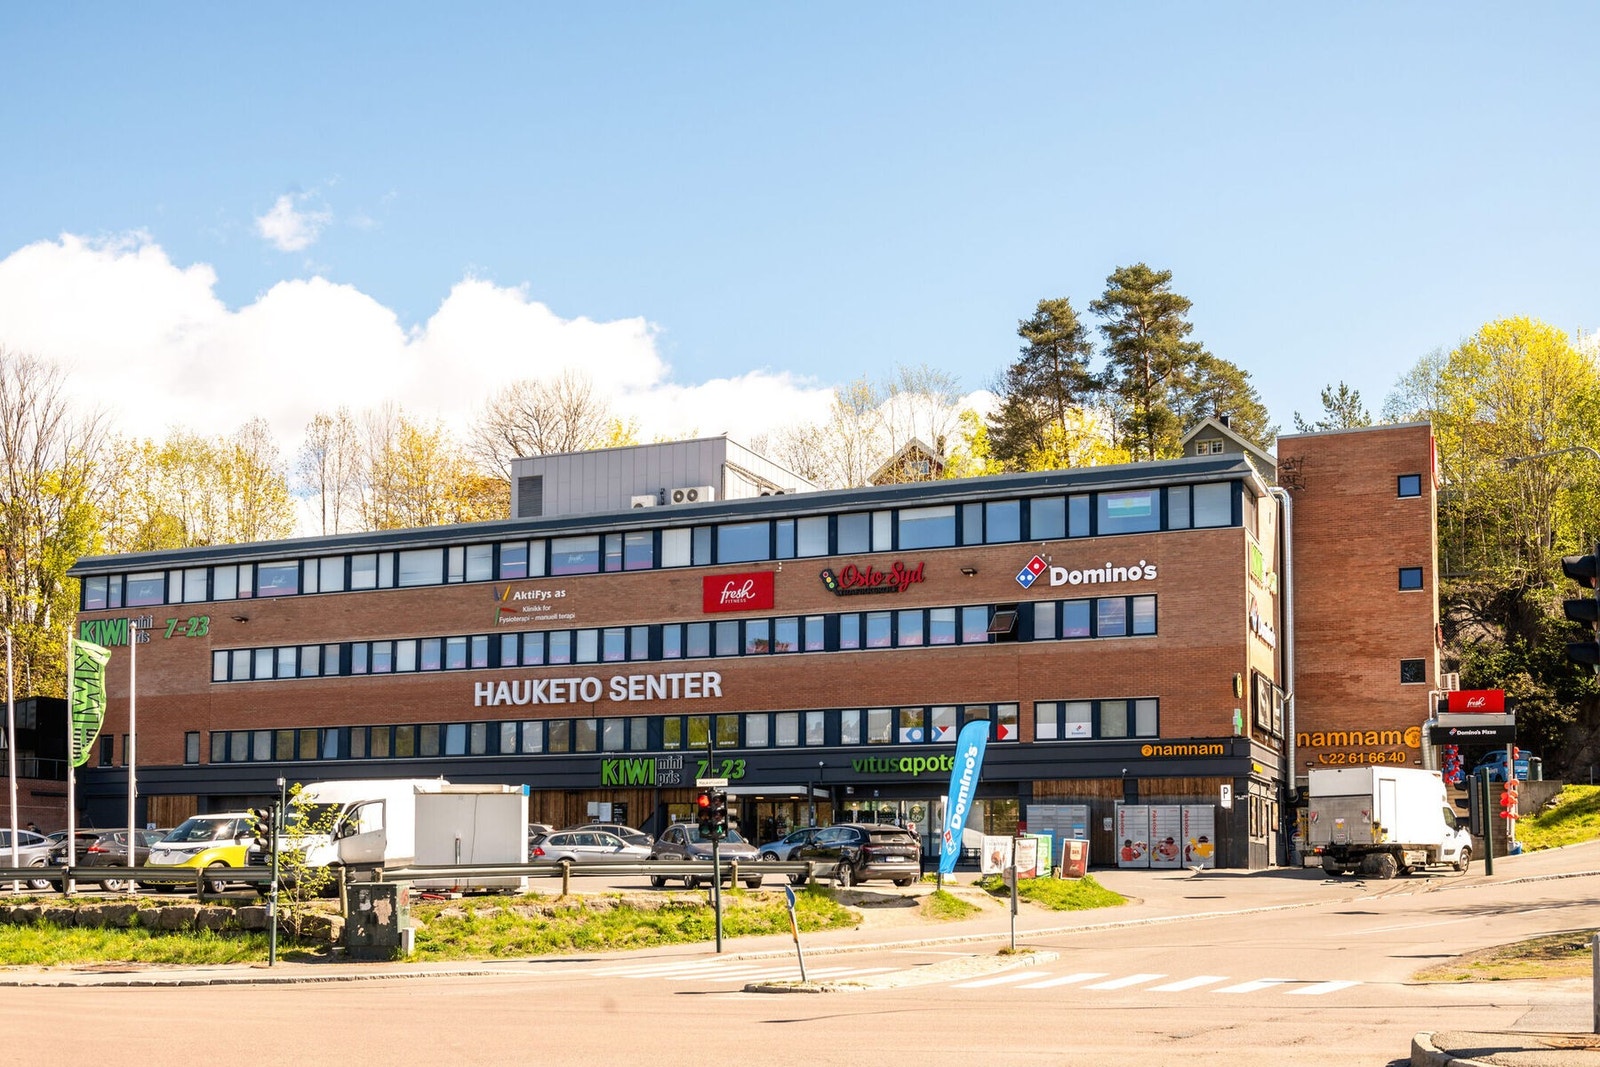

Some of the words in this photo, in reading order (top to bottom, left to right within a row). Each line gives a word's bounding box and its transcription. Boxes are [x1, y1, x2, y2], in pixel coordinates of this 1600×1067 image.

[838, 563, 884, 589] Oslo
[886, 561, 925, 592] Syd
[1050, 560, 1157, 586] Domino's
[513, 590, 552, 601] AktiFys
[554, 589, 566, 598] as
[720, 579, 755, 604] fresh
[499, 614, 530, 624] Fysioterapi
[535, 613, 558, 621] manuell
[559, 612, 576, 620] terapi
[80, 618, 128, 646] KIWI
[164, 615, 210, 639] 7-23
[474, 677, 603, 707] HAUKETO
[609, 671, 722, 701] SENTER
[1467, 696, 1486, 708] fresh
[1296, 730, 1402, 747] namnam
[1153, 744, 1224, 756] namnam
[1329, 753, 1345, 764] 22
[1348, 752, 1364, 763] 61
[1368, 752, 1385, 763] 66
[1388, 751, 1406, 763] 40
[657, 755, 683, 769] mini
[852, 754, 956, 776] vitusapote
[601, 758, 654, 786] KIWI
[695, 759, 746, 779] 7-23
[657, 770, 680, 786] pris
[951, 744, 978, 830] Domino's
[1223, 786, 1229, 799] P
